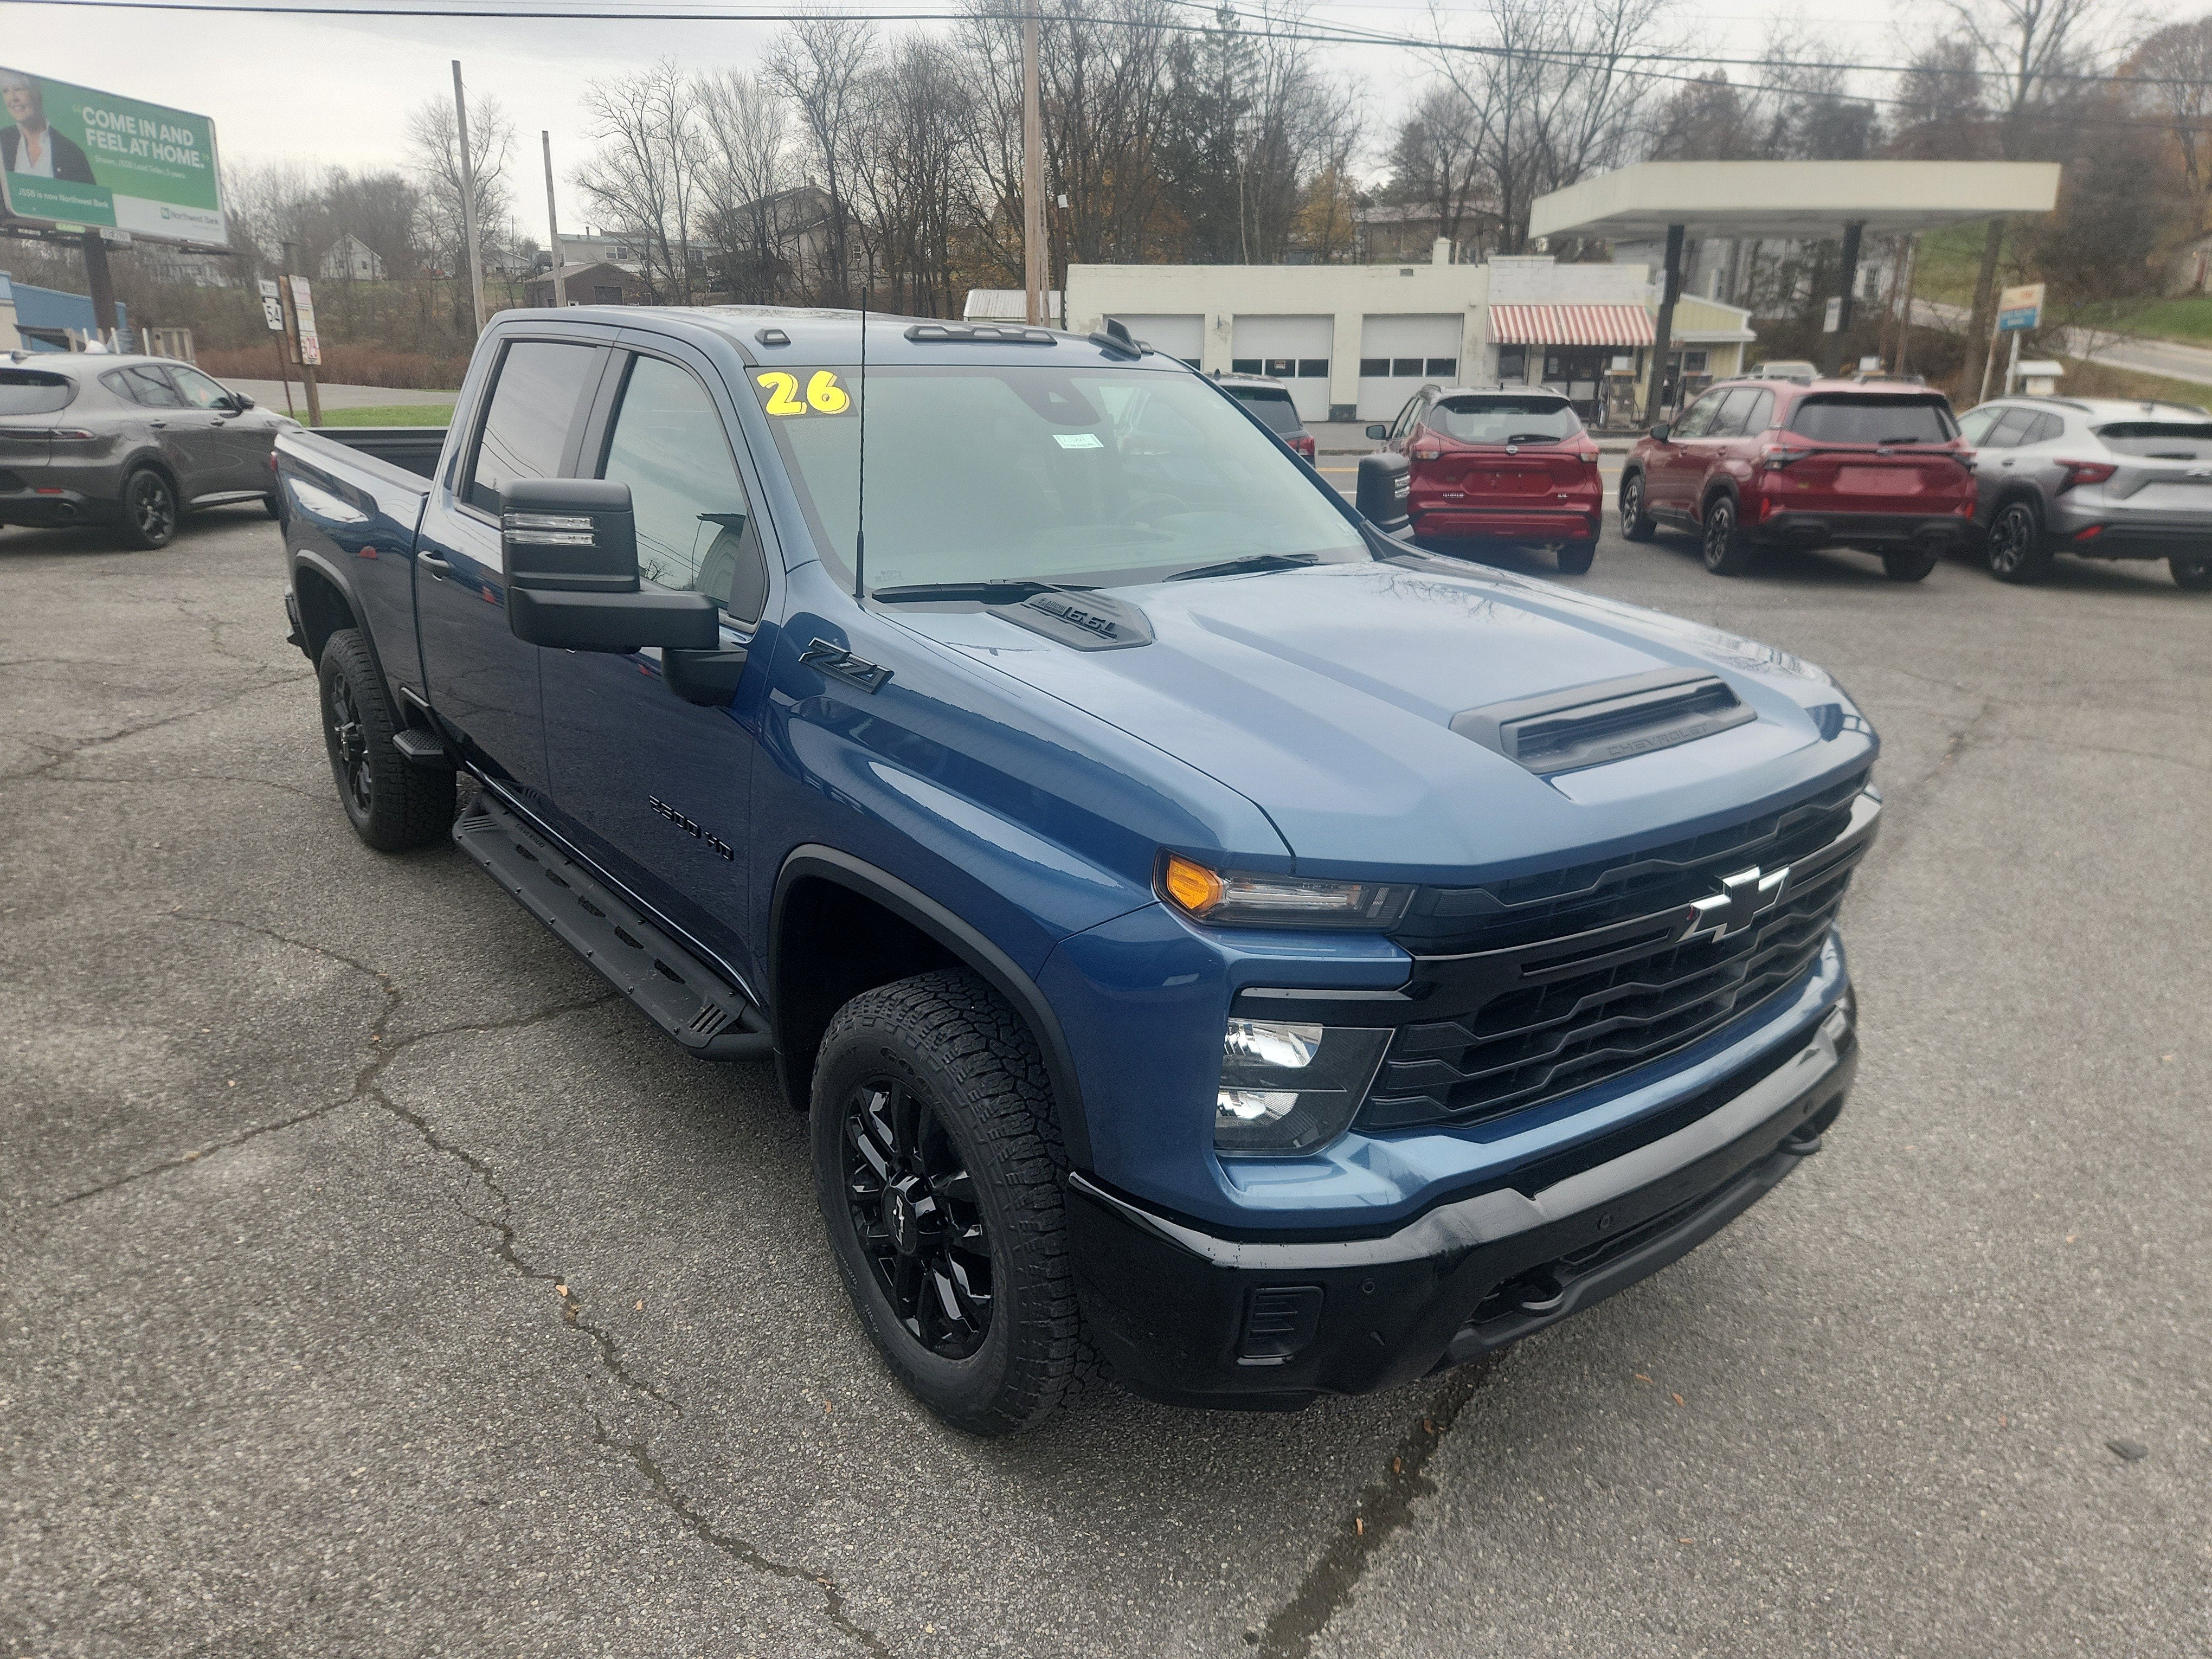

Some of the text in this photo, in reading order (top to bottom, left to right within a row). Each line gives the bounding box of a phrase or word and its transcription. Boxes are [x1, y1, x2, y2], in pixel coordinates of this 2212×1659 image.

[82, 106, 194, 147] COME IN AND
[85, 127, 205, 169] FEEL AT HOME.
[37, 190, 43, 198] is
[59, 194, 92, 205] Northwest
[93, 198, 109, 208] Bank
[267, 305, 280, 323] 54
[756, 370, 850, 416] 26
[798, 636, 895, 695] Z71
[1606, 723, 1707, 756] CHEVROLET
[649, 794, 735, 862] 2500 HD
